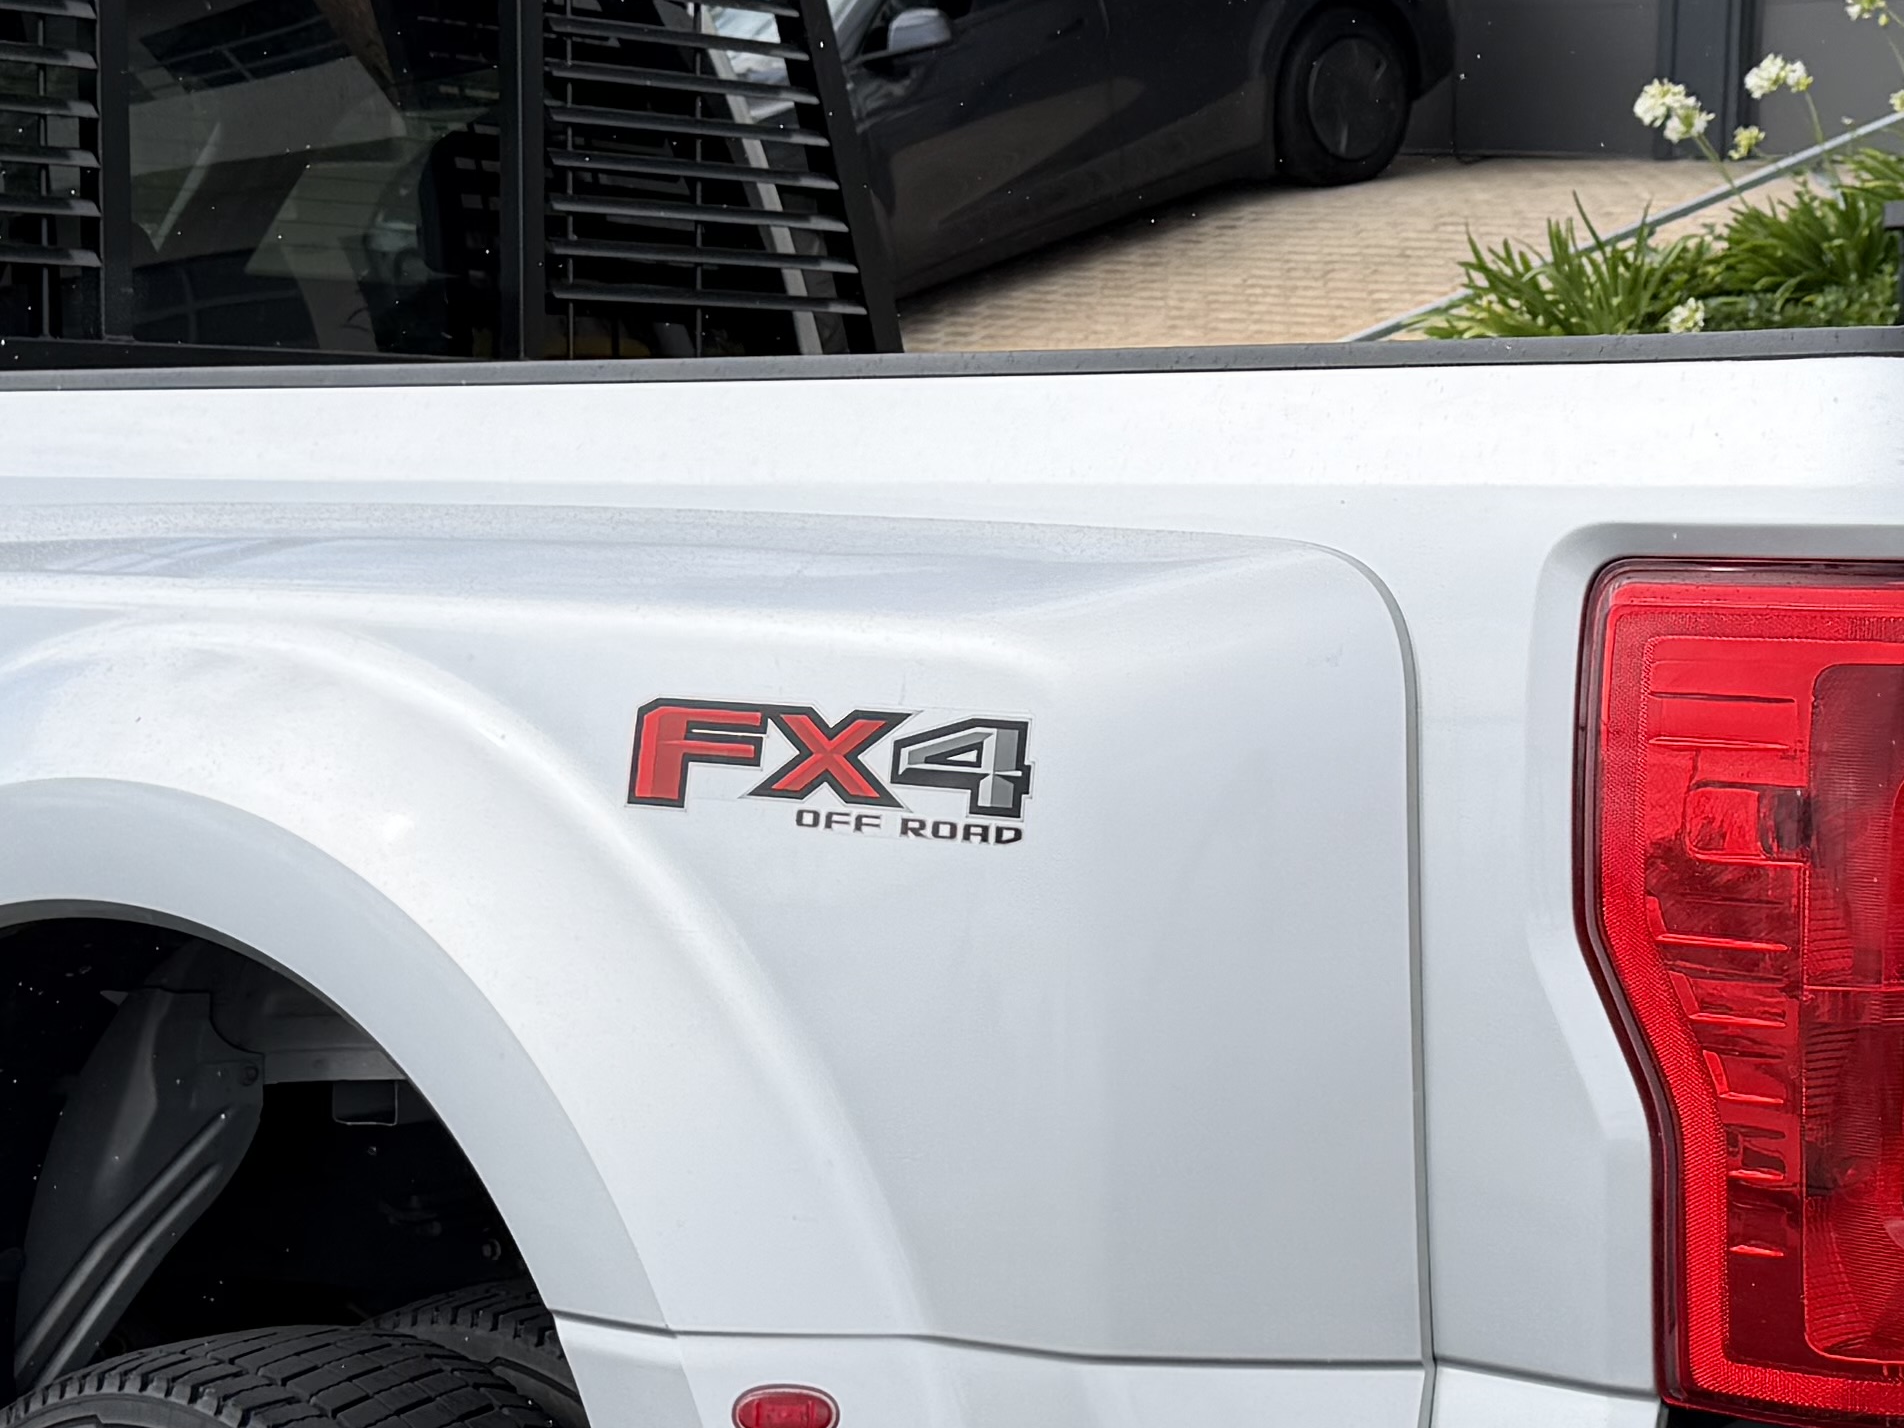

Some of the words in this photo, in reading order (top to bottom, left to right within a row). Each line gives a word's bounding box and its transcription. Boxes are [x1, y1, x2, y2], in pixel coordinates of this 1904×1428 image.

[626, 696, 1033, 820] FX4
[794, 808, 883, 835] OFF
[899, 816, 1023, 845] ROAD
